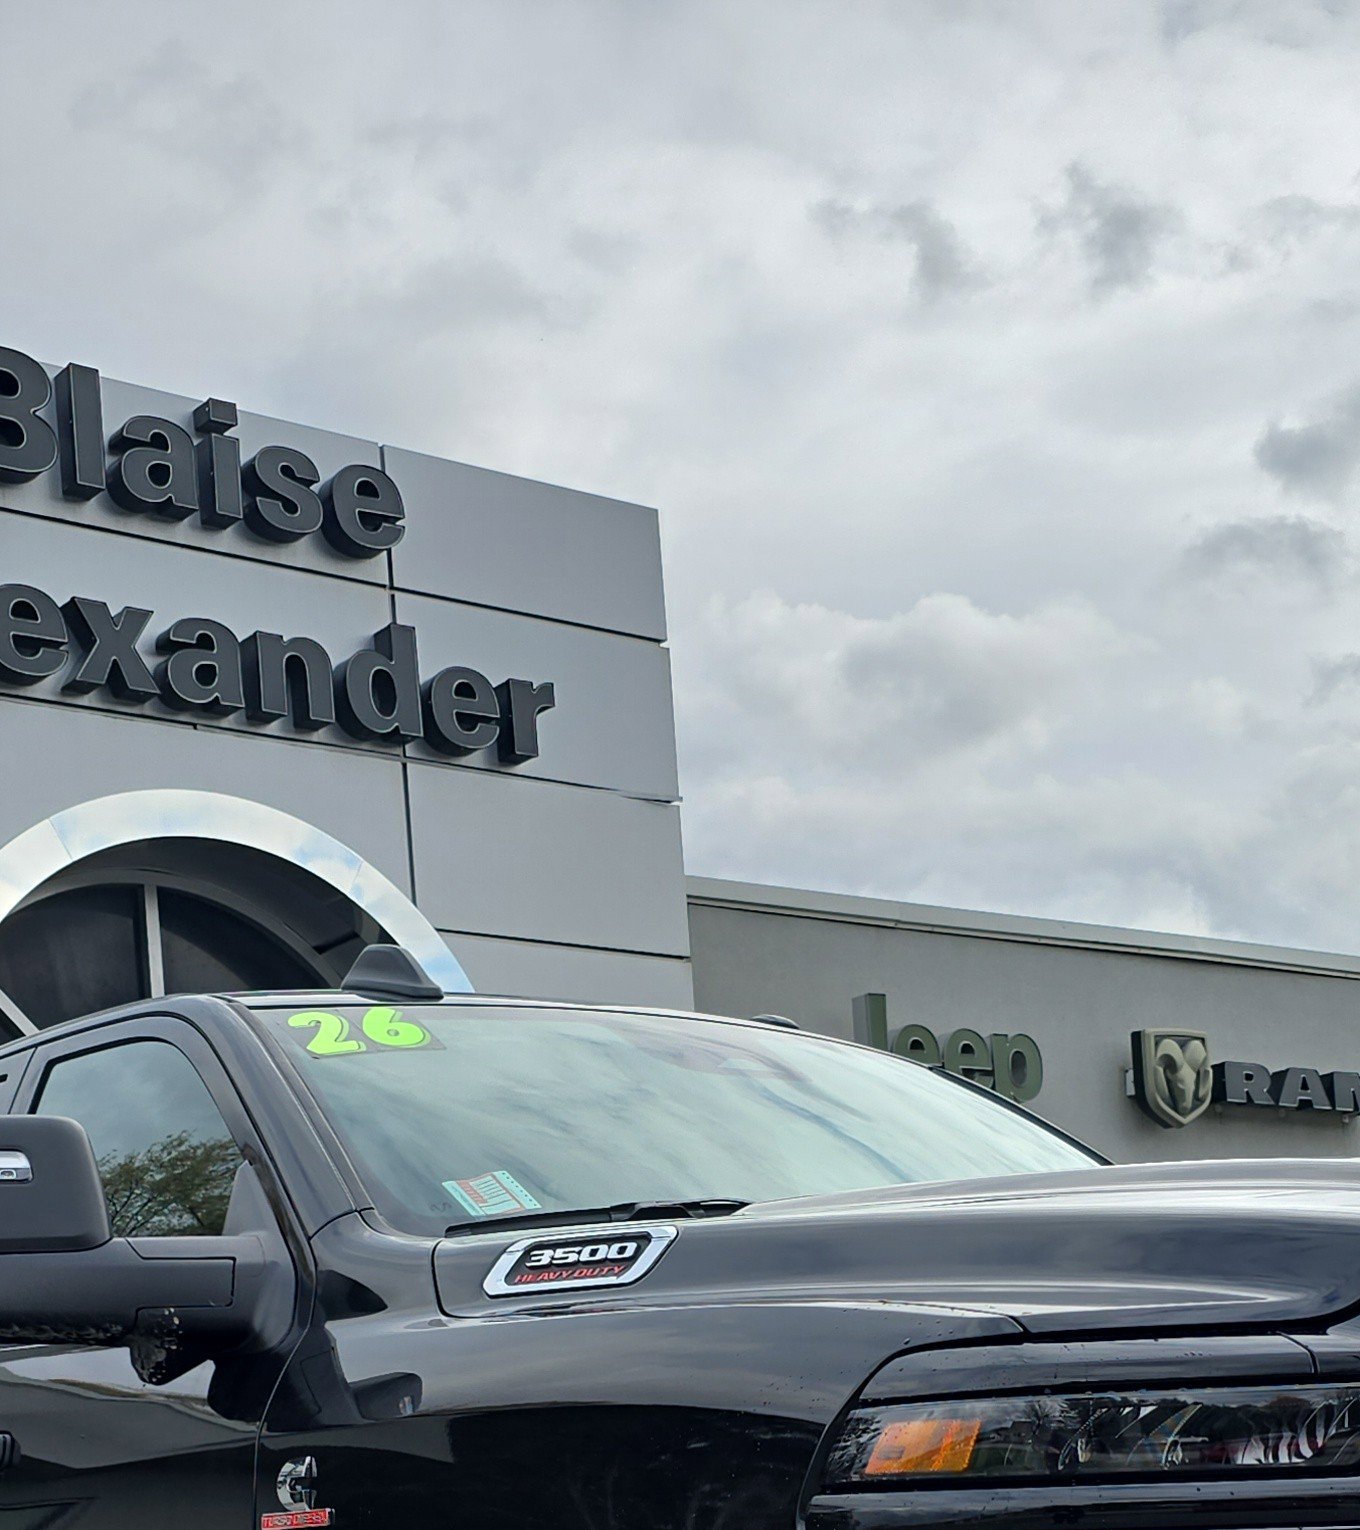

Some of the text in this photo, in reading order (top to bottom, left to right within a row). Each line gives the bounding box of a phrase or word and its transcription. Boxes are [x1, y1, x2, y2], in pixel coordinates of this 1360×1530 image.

[287, 1006, 433, 1056] 26
[525, 1241, 638, 1267] 3500
[514, 1264, 627, 1284] HEAVY DUTY
